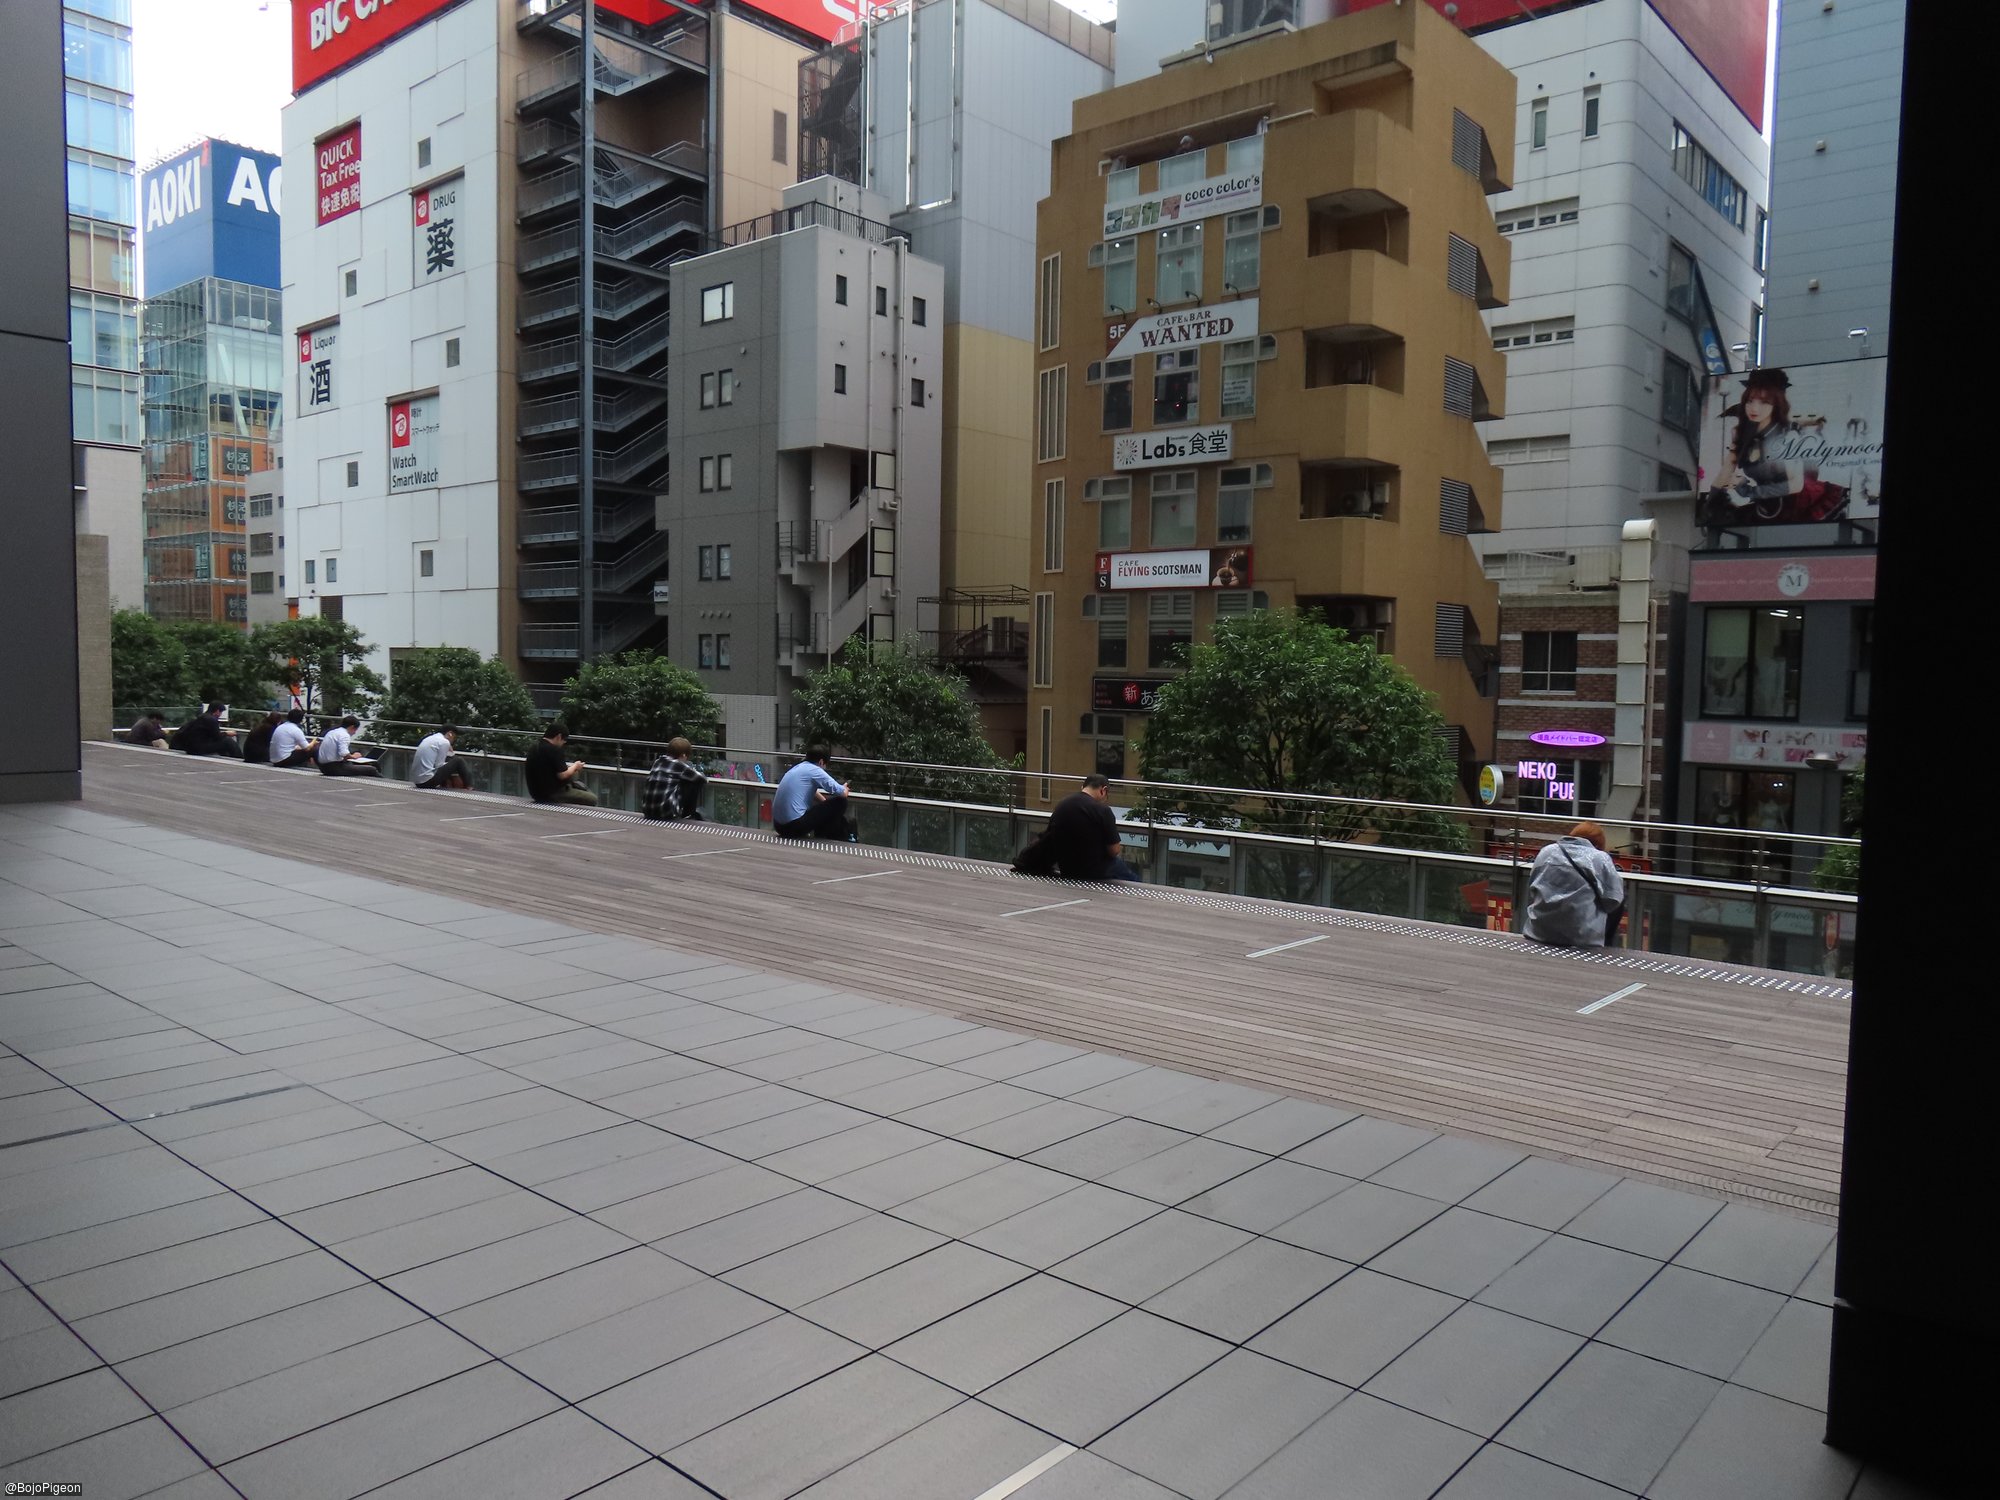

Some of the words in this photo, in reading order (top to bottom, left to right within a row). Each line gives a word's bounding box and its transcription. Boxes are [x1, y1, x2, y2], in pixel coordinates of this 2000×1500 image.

[310, 0, 350, 50] BIC
[320, 138, 354, 169] QUICK
[227, 156, 281, 217] A
[320, 170, 338, 189] Tax
[339, 160, 361, 182] Free
[146, 155, 201, 232] AOKI
[321, 182, 361, 217] 快速免税
[433, 191, 456, 210] DRUG
[1185, 187, 1214, 202] coco
[1216, 175, 1260, 194] color's
[426, 218, 454, 275] 薬
[314, 335, 336, 351] Liquor
[1109, 324, 1127, 339] 5F
[1140, 317, 1234, 348] WANTED
[309, 359, 331, 406] 酒
[1142, 436, 1186, 460] Labs
[1189, 429, 1228, 456] 食堂
[392, 453, 417, 470] Watch
[1100, 558, 1108, 569] F
[1118, 566, 1150, 577] FLYING
[1152, 564, 1202, 576] SCOTSMAN
[1100, 575, 1107, 588] S
[1786, 575, 1802, 587] M
[1124, 685, 1137, 701] 新
[1518, 761, 1557, 781] NEKO
